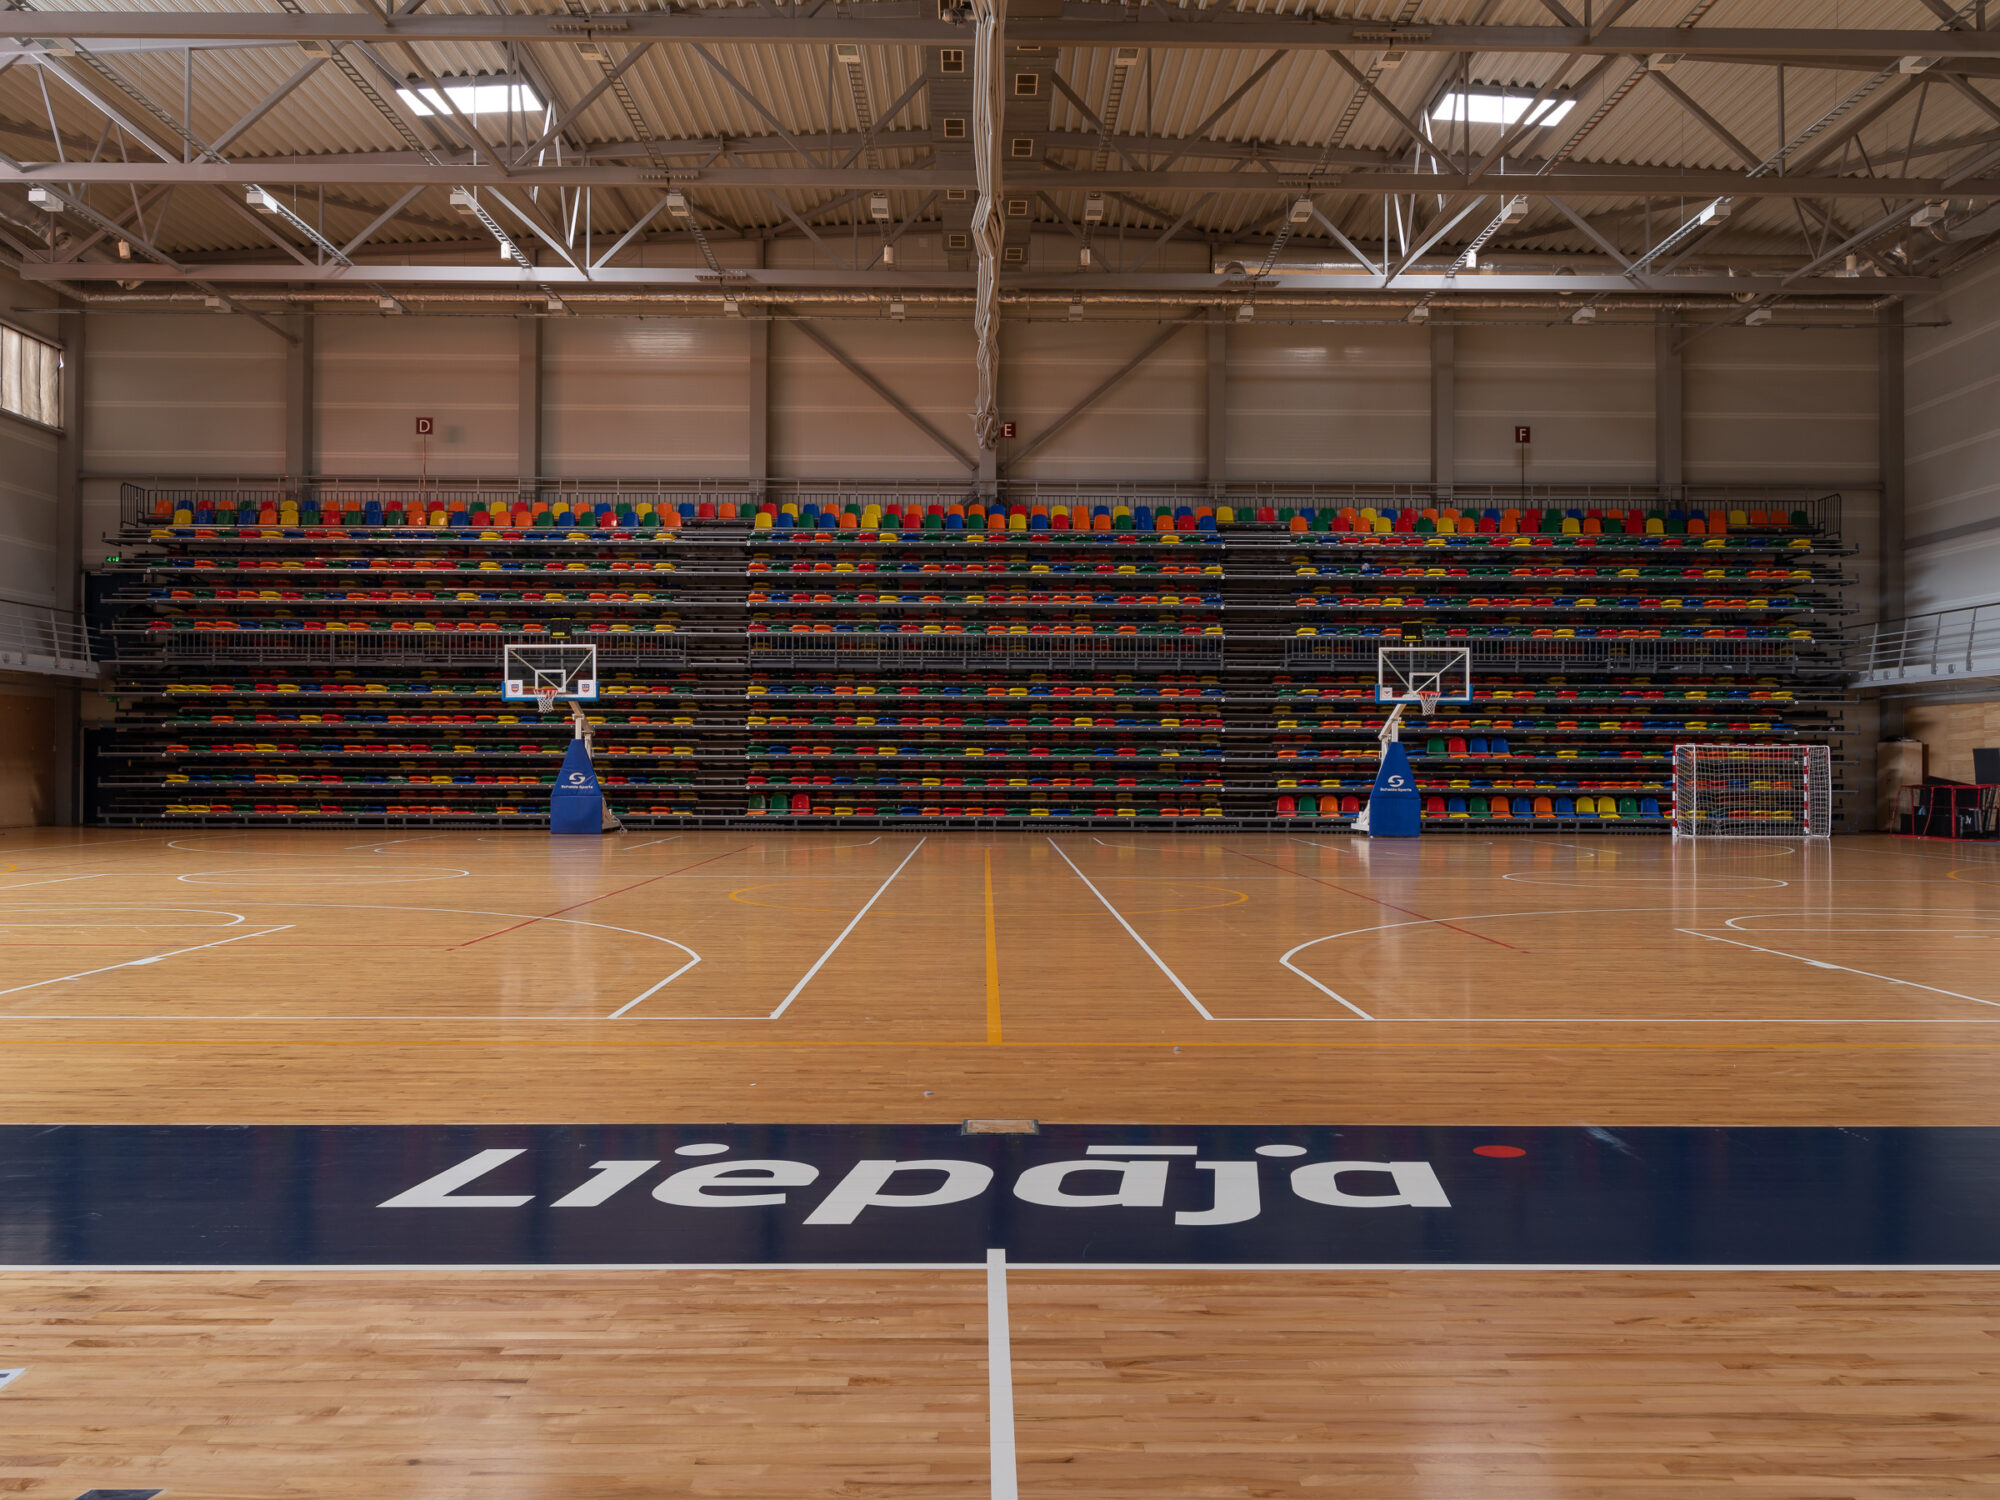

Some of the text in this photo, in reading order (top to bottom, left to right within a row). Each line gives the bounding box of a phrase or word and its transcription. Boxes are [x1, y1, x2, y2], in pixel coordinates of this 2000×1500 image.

[419, 419, 431, 433] D
[1003, 423, 1013, 437] E
[1519, 428, 1527, 442] F
[376, 1144, 1452, 1226] Liepāja
